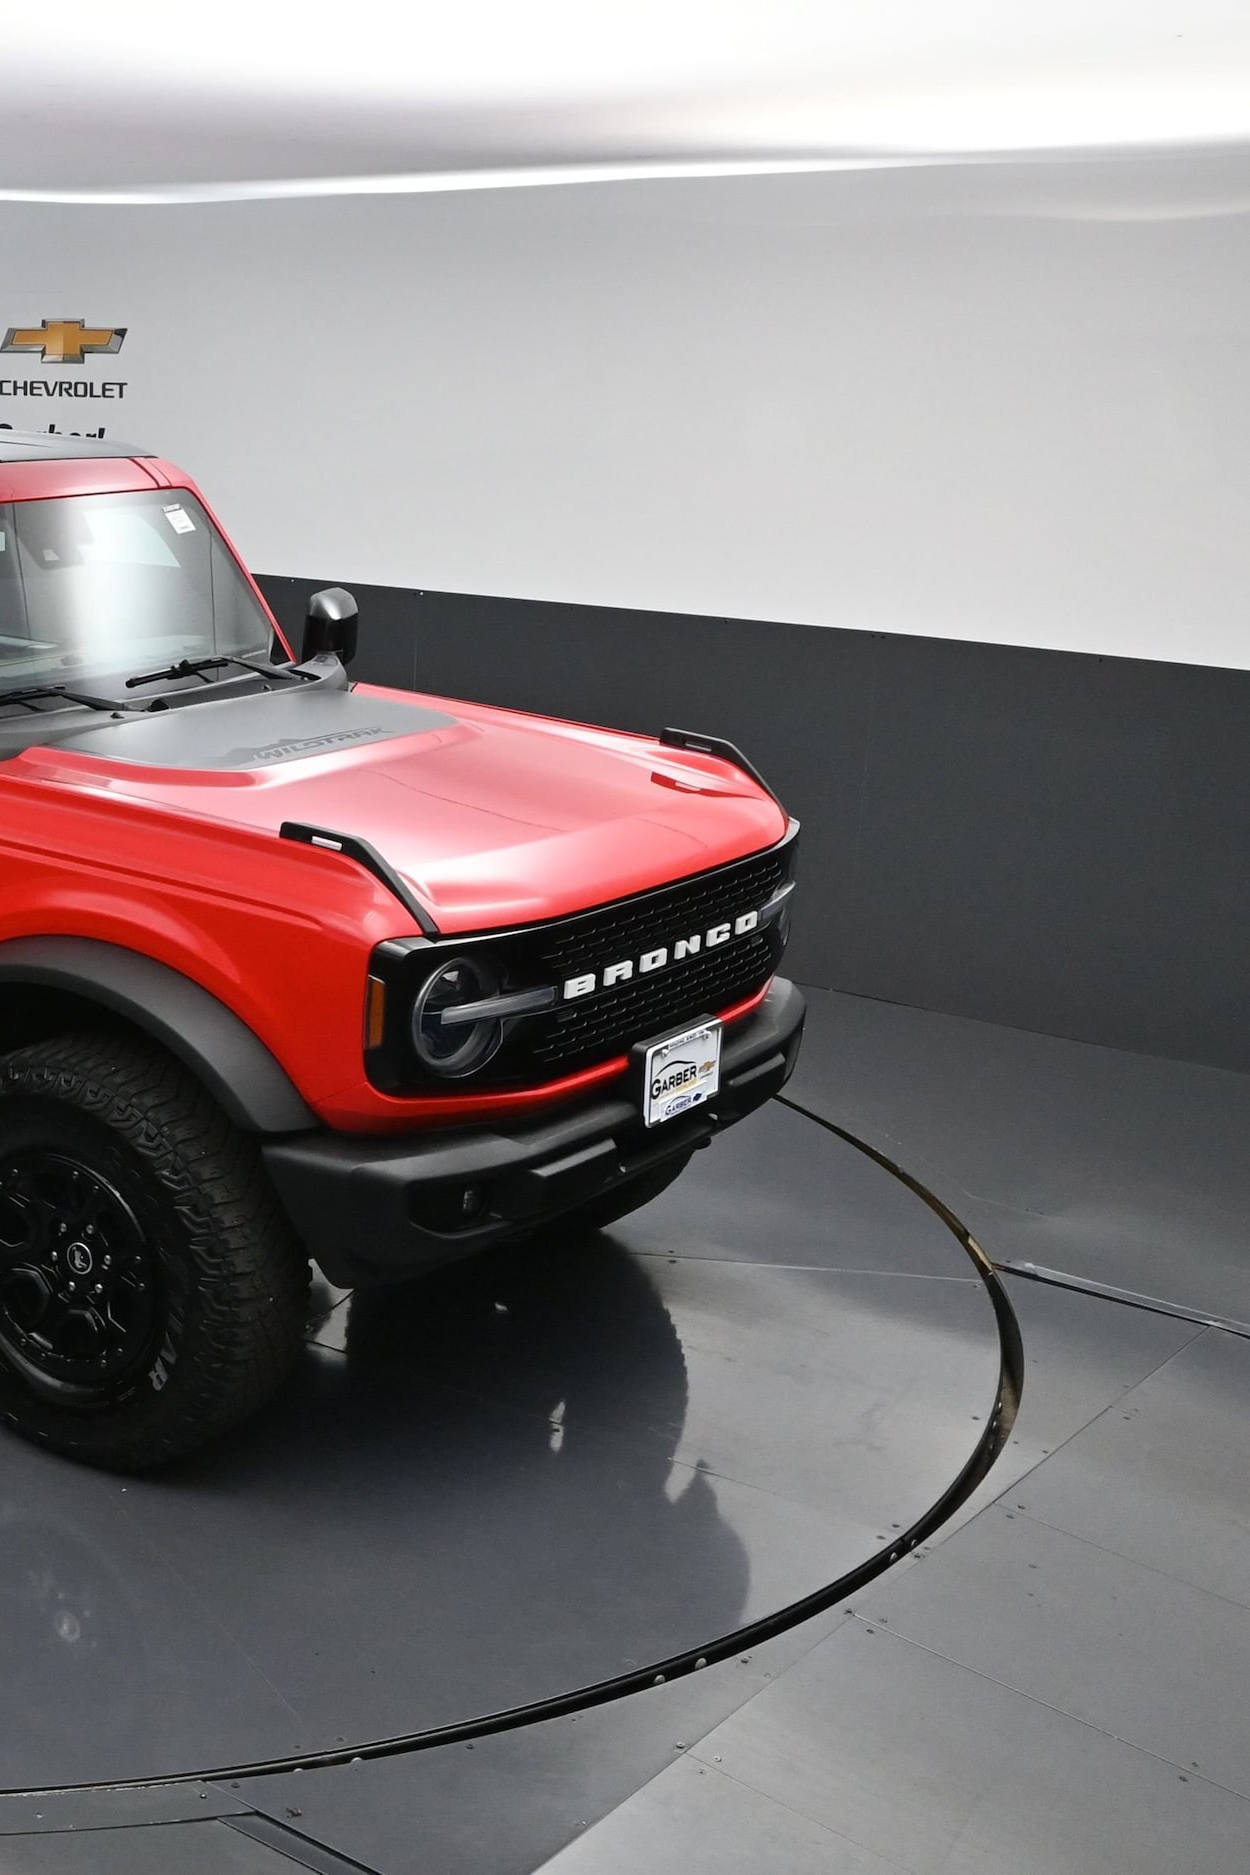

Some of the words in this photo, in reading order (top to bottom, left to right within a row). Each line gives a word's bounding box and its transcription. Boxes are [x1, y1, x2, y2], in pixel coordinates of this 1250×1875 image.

[253, 727, 393, 760] WILDTRAK
[563, 910, 758, 1000] BRONCO
[651, 1065, 698, 1100] GARBER
